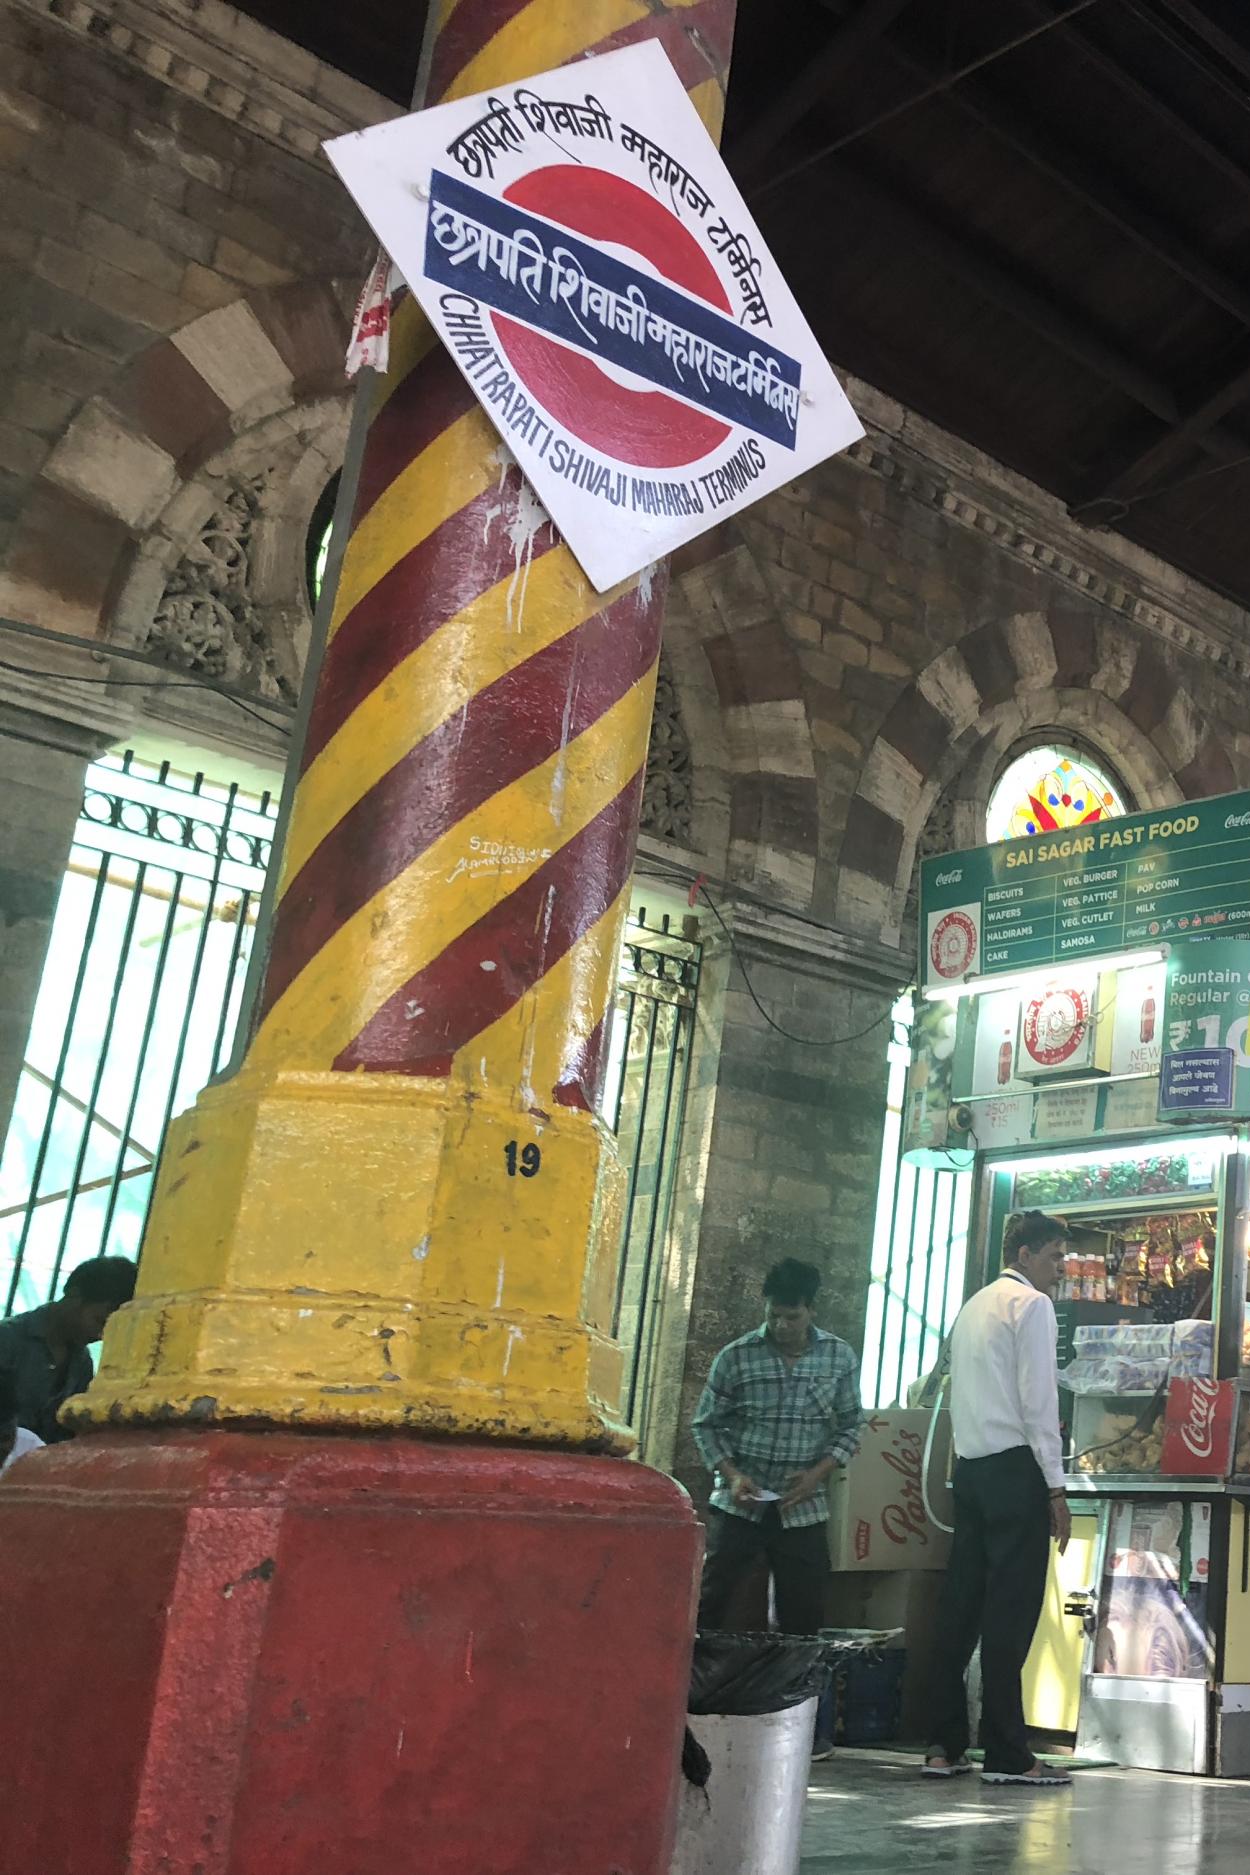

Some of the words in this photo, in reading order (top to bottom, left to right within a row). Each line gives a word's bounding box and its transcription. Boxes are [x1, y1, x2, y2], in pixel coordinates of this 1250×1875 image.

[446, 96, 525, 179] छत्रपती
[514, 89, 613, 164] शिवाजी
[620, 123, 715, 217] महाराज
[707, 217, 772, 328] टर्मिनस
[431, 200, 547, 304] छत्रपति
[549, 246, 648, 346] शिवाजी
[647, 311, 735, 393] महाराज
[732, 351, 800, 430] टर्मिनस
[439, 293, 553, 458] CHHATRAPATI
[549, 440, 626, 507] SHIVAJI
[632, 478, 703, 516] MAHARAJ
[700, 437, 766, 509] TERMINUS
[1006, 849, 1034, 868] SAI
[1038, 838, 1095, 860] SAGAR
[1100, 827, 1144, 849] FAST
[1149, 816, 1200, 840] FOOD
[1138, 862, 1156, 874] PAV
[935, 869, 964, 887] Coca-Cola
[1063, 876, 1081, 887] VEG.
[1083, 870, 1118, 884] BURGER
[1137, 883, 1154, 895] POP
[1155, 878, 1179, 890] CORN
[988, 887, 1024, 902] BISCUITS
[1062, 896, 1080, 908] VEG.
[1082, 890, 1118, 904] PATTICE
[988, 908, 1021, 921] WAFERS
[1136, 902, 1156, 914] MILK
[1061, 917, 1079, 929] VEG.
[1081, 911, 1114, 925] CUTLET
[987, 925, 1033, 942] HALDIRAMS
[1061, 935, 1096, 950] SAMOSA
[987, 950, 1009, 962] CAKE
[1171, 969, 1242, 987] Fountain
[1170, 990, 1228, 1008] Regular
[1130, 1047, 1160, 1061] NEW
[504, 1140, 541, 1177] 19
[1180, 1377, 1221, 1458] Coca-C
[881, 1430, 928, 1545] Parle's
